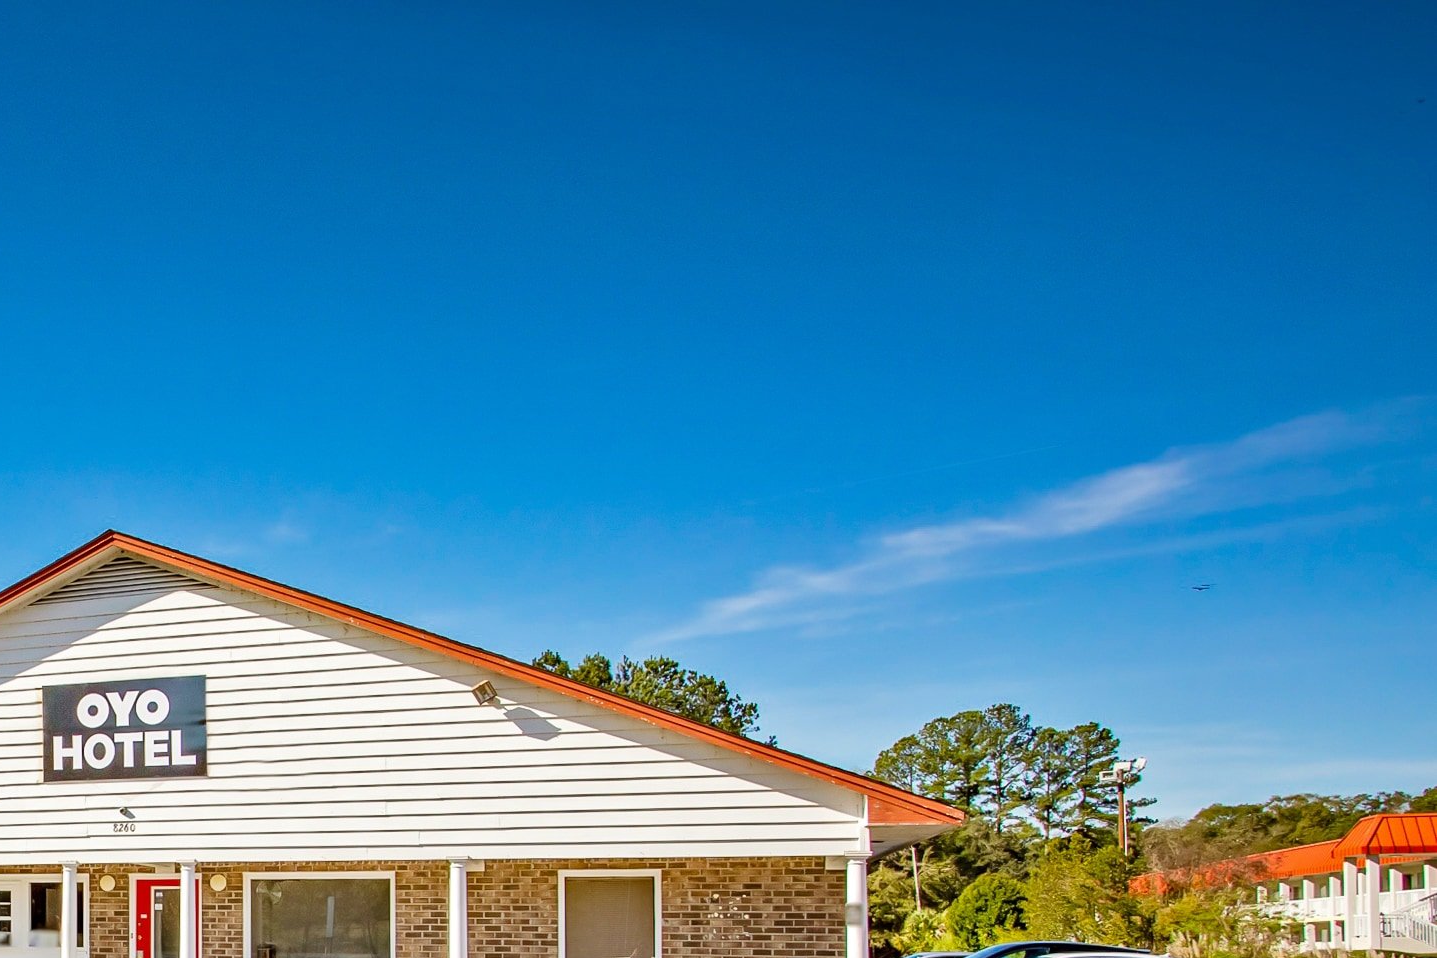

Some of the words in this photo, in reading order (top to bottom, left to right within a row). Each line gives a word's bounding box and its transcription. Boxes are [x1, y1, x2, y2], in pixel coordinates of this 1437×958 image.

[77, 689, 170, 728] OYO
[52, 730, 197, 770] HOTEL
[113, 823, 136, 833] 8260
